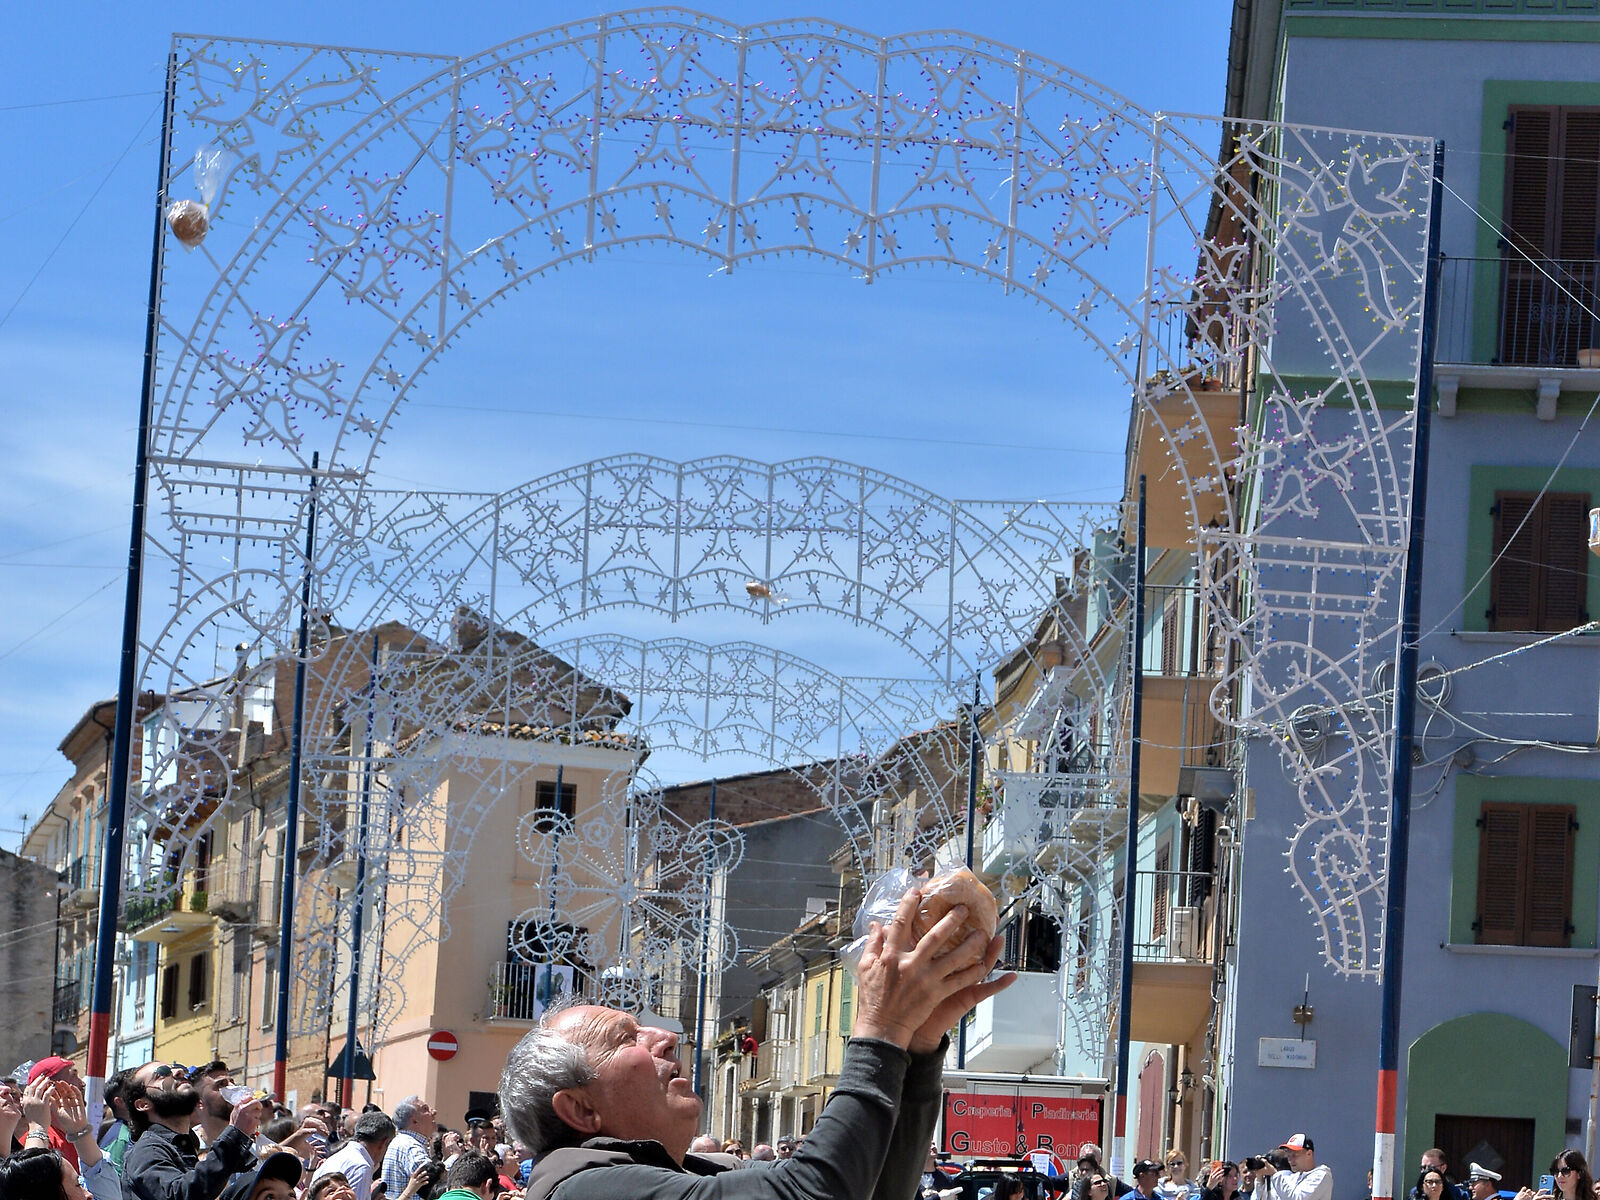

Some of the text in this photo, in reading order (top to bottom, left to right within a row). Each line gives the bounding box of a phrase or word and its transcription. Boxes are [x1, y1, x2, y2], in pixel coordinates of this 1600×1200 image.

[950, 1130, 1092, 1158] Gusto & Bon
